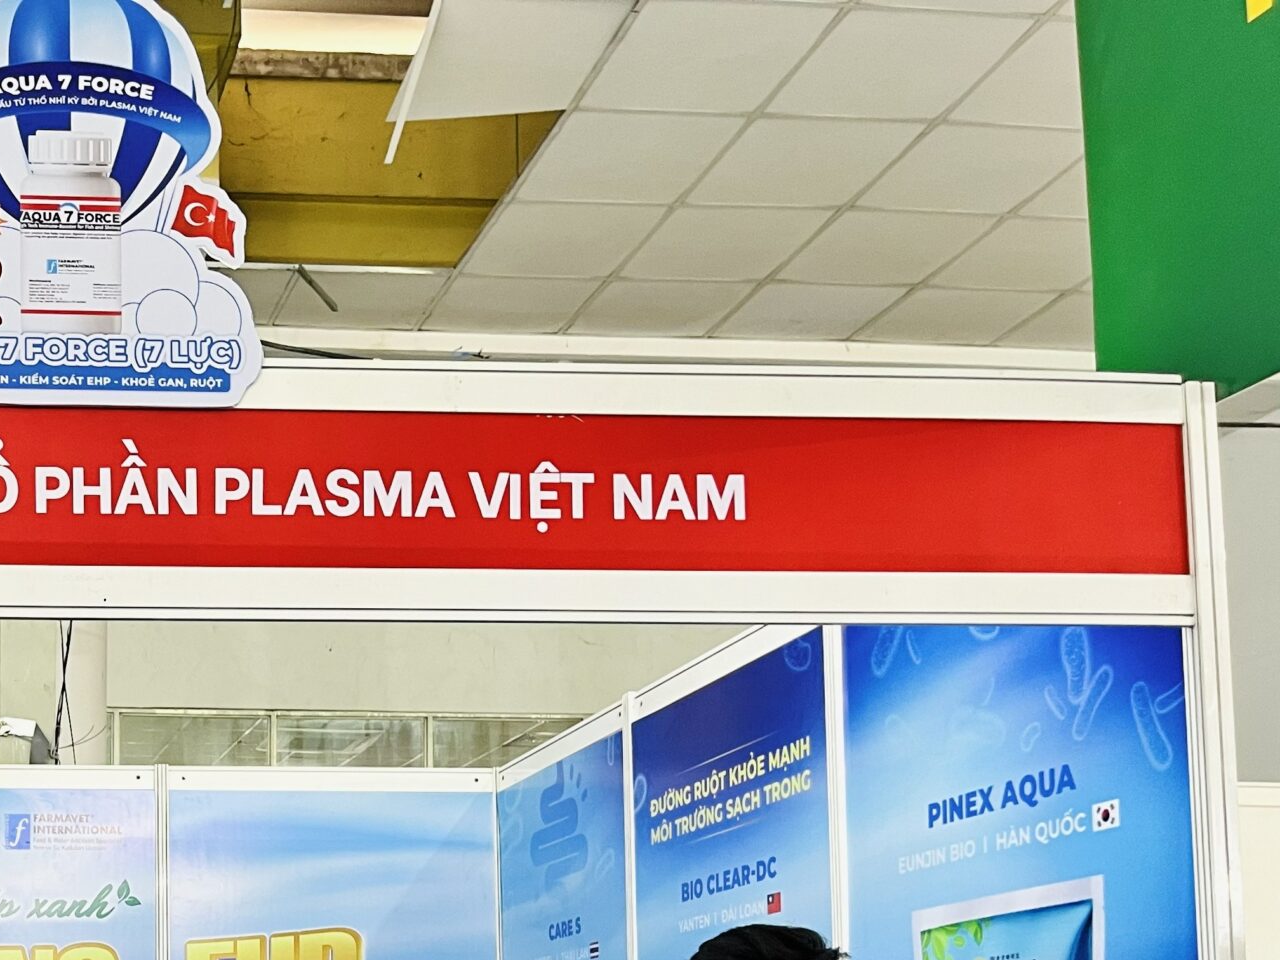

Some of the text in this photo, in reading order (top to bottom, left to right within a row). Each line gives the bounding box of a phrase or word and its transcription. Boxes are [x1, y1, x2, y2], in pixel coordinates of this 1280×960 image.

[58, 75, 71, 90] 7
[78, 75, 155, 100] FORCE
[100, 99, 137, 112] PLASMA
[138, 105, 159, 117] VIỆT
[160, 111, 182, 124] NAM
[22, 210, 120, 223] AQUA 7 FORCE
[25, 339, 128, 363] FORCE
[134, 339, 165, 368] (7
[171, 337, 242, 370] LỰC)
[52, 375, 85, 386] SOÁT
[87, 377, 111, 386] EHP
[158, 378, 188, 389] GAN,
[190, 377, 223, 390] RUỘT
[35, 439, 198, 515] PHẦN
[215, 467, 455, 518] PLASMA
[468, 461, 595, 533] VIỆT
[612, 473, 746, 521] NAM
[650, 736, 811, 817] ĐƯỜNG RUỘT KHỎE MẠNH
[650, 769, 812, 846] MÔI TRƯỜNG SẠCH TRONG
[927, 763, 1077, 829] PINEX AQUA
[33, 814, 90, 823] FARMAVET
[33, 825, 123, 835] INTERNATIONAL
[898, 848, 947, 875] EUNJIN
[950, 840, 976, 861] BIO
[995, 824, 1031, 852] HÀN
[1035, 808, 1087, 844] QUỐC
[681, 856, 777, 903] BIO CLEAR-DC
[26, 883, 115, 919] xanh
[549, 916, 581, 941] CARE S
